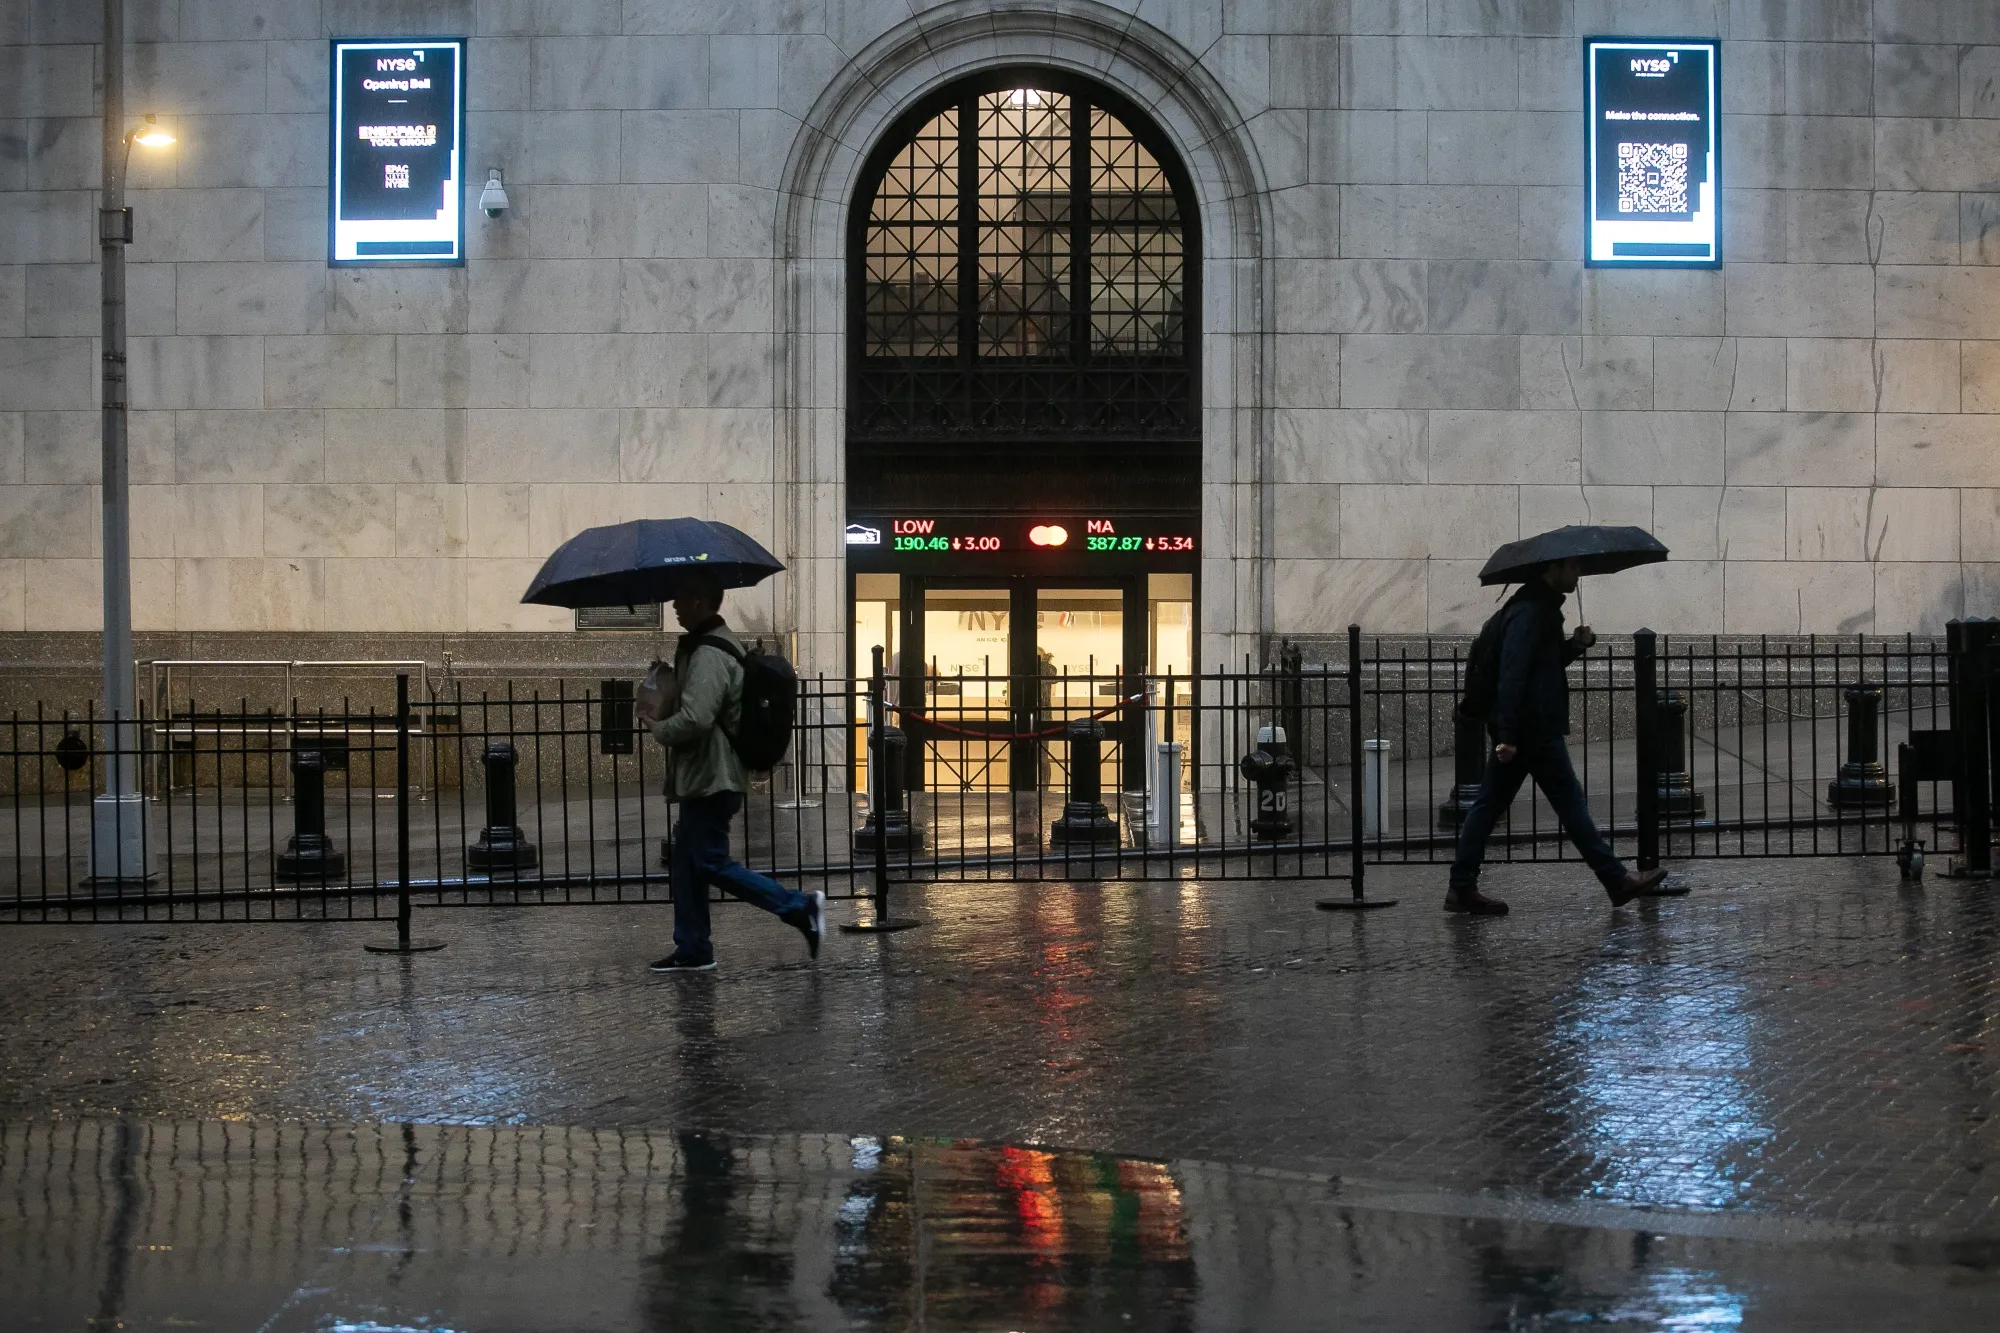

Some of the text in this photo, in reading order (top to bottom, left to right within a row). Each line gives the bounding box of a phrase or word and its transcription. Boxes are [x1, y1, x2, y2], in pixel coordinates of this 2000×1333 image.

[363, 78, 431, 91] Opening Bell
[1605, 110, 1700, 121] Make the connection.
[894, 520, 935, 534] LOW
[1087, 520, 1115, 534] MA
[894, 537, 1000, 550] 190.46 3.00
[1087, 537, 1194, 550] 387.87 5.34
[1261, 790, 1286, 812] 20
